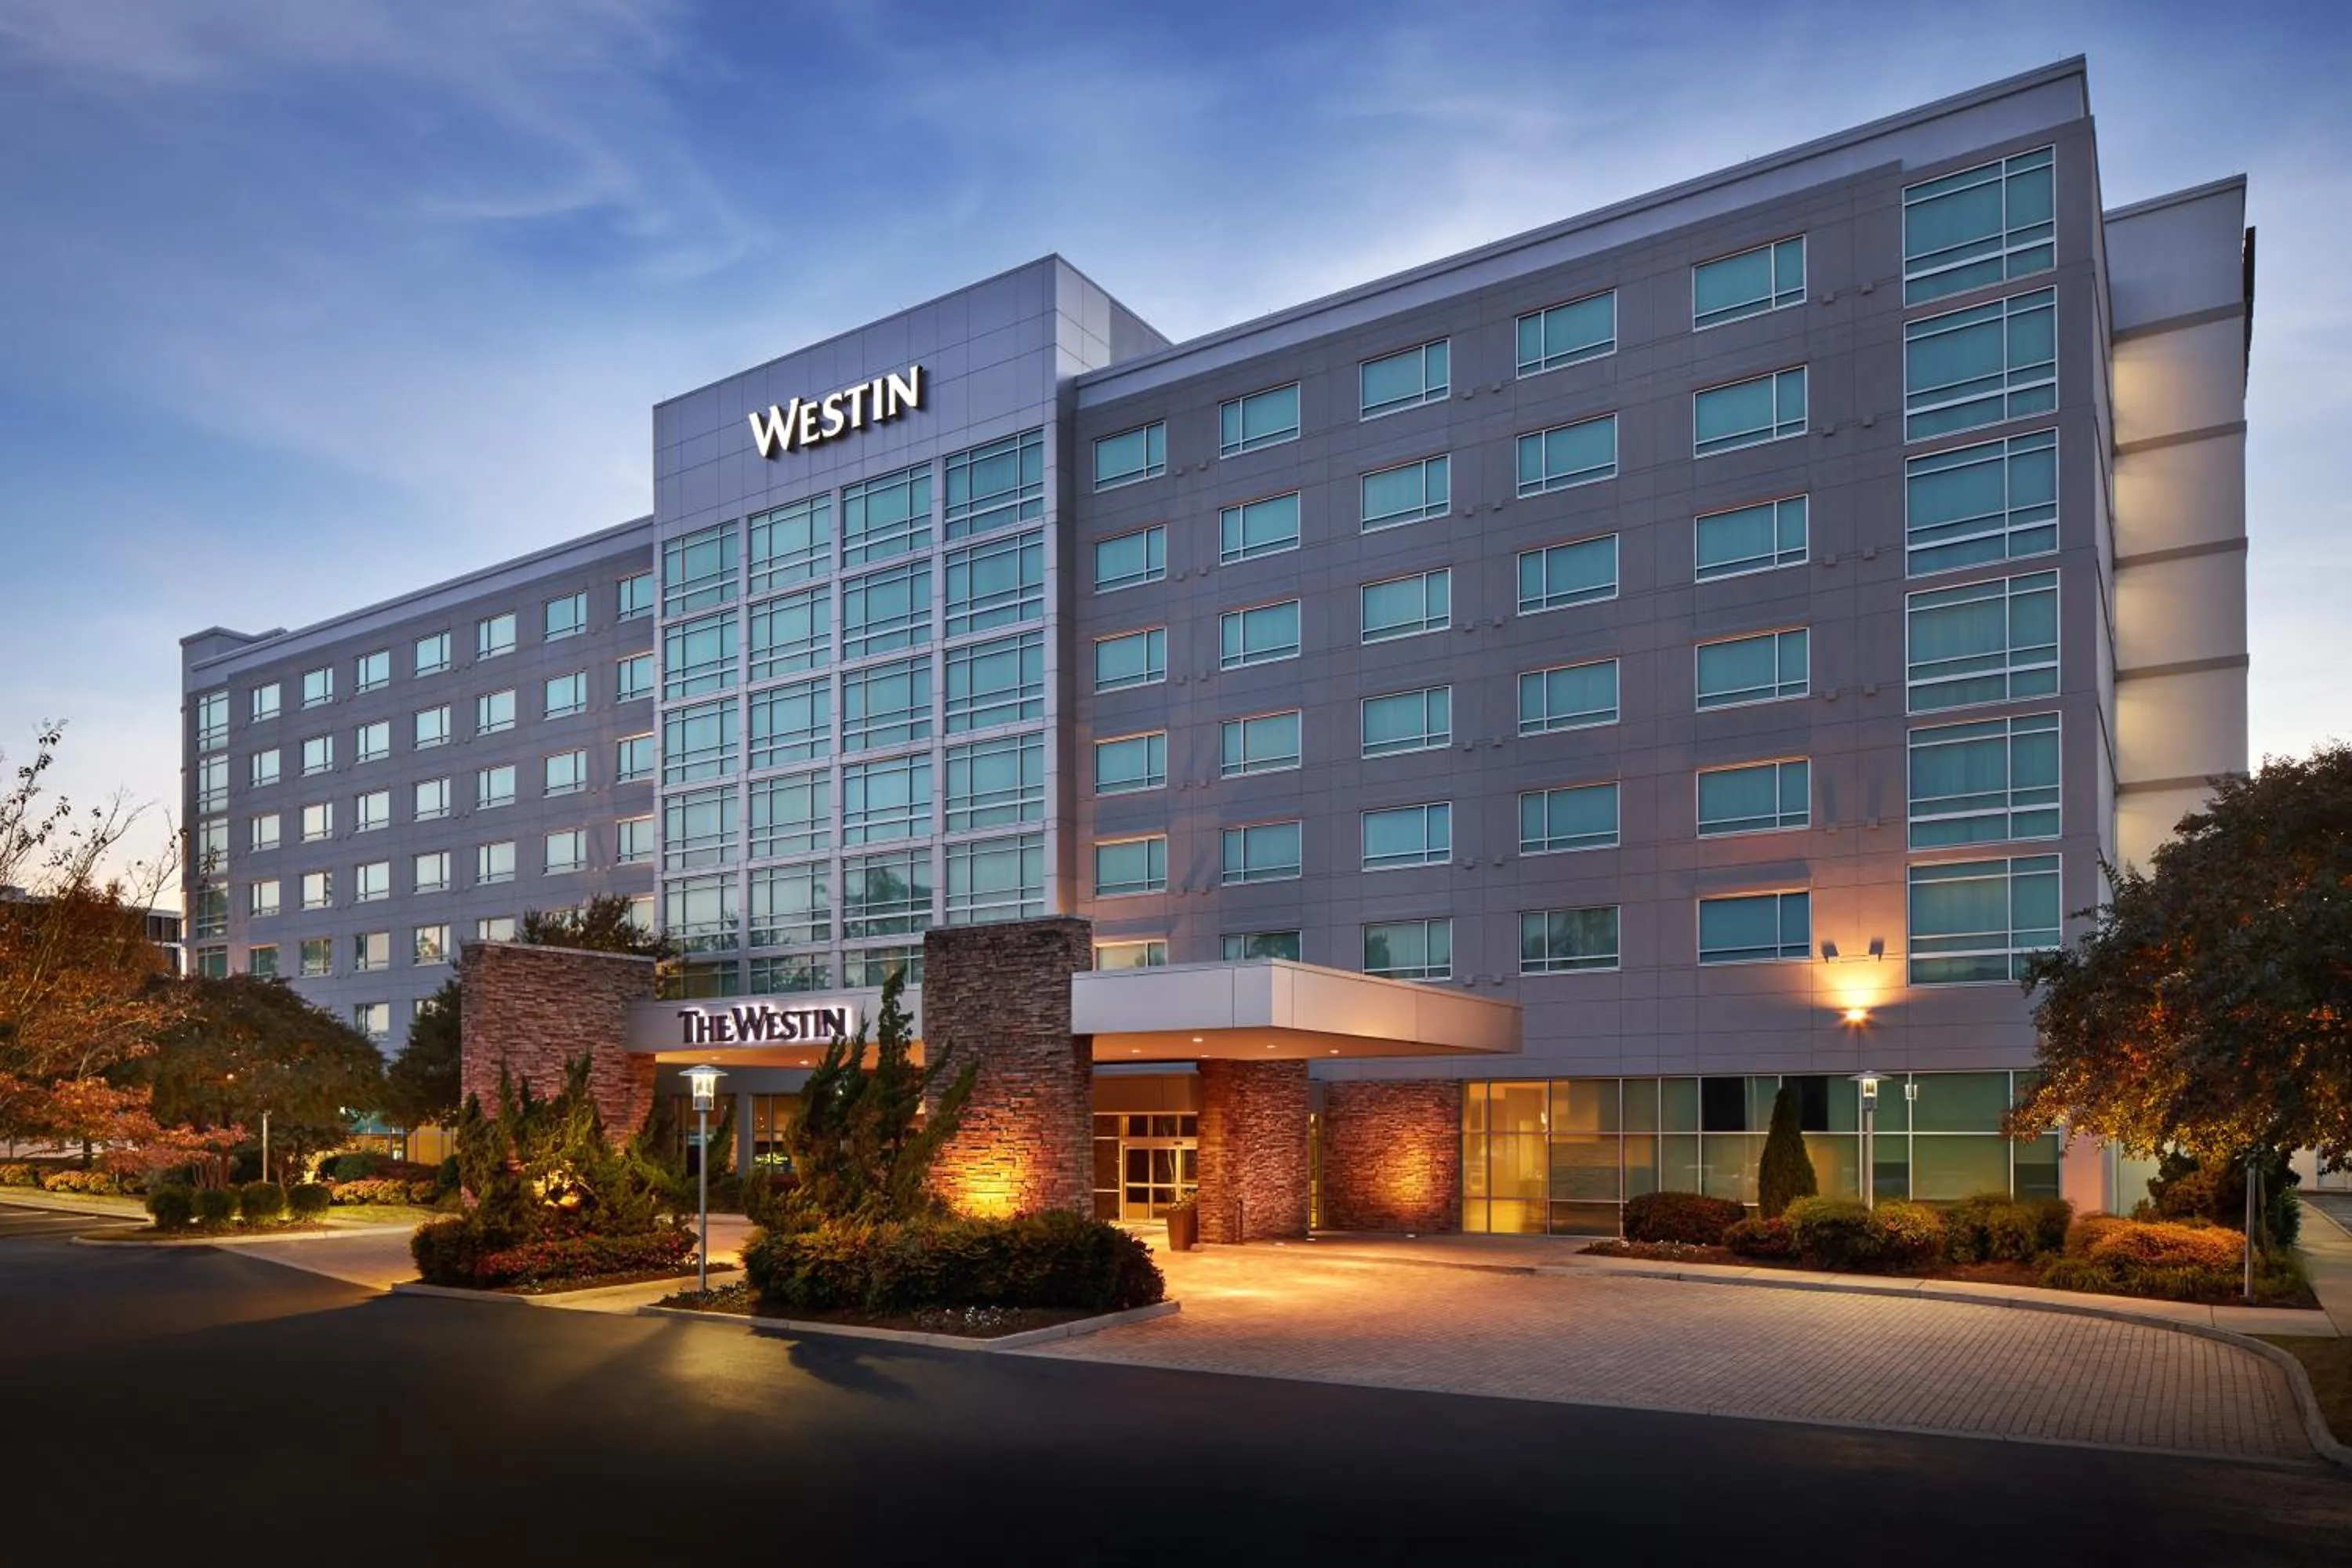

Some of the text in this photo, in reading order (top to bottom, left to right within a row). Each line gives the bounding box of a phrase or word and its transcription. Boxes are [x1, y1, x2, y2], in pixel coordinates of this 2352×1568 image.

[749, 365, 923, 458] WESTIN
[677, 1006, 846, 1044] THE WESTIN
